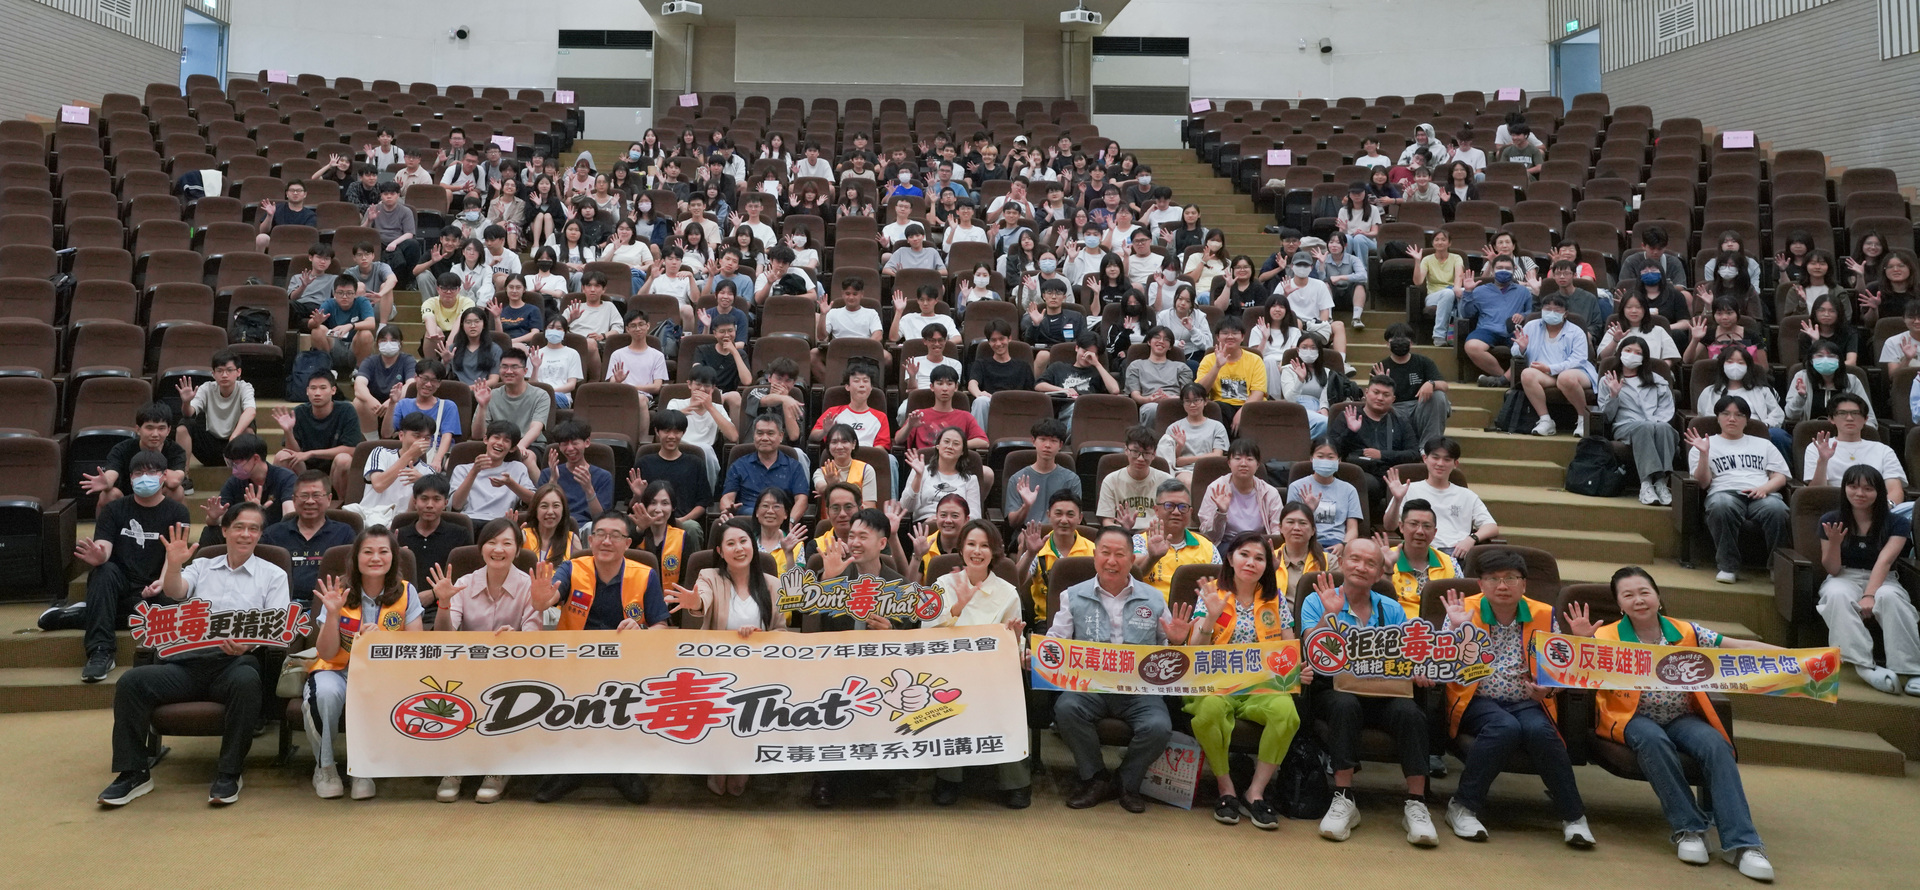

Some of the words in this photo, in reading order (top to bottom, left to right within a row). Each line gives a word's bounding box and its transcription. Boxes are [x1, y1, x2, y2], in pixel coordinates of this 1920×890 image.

[1712, 456, 1737, 473] NEW
[1738, 454, 1764, 471] YORK
[1118, 496, 1155, 508] MICHIGA
[803, 584, 848, 608] Don't
[847, 579, 883, 618] 毒
[878, 593, 918, 616] That
[143, 600, 302, 648] 無毒更精彩!
[370, 643, 620, 659] 國際獅子會300E-2區
[678, 637, 998, 660] 2026-2027年度反毒委員會
[1043, 640, 1060, 665] 毒
[1347, 623, 1459, 662] 拒絕毒品
[1549, 641, 1569, 663] 毒
[1068, 645, 1135, 674] 反毒雄獅
[1194, 648, 1263, 675] 高興有您
[1354, 661, 1454, 679] 擁抱更好的自己
[1578, 643, 1652, 677] 反毒雄獅
[1719, 654, 1800, 678] 高興有您
[485, 684, 642, 731] Don't
[635, 671, 735, 741] 毒
[726, 688, 851, 732] That
[914, 712, 942, 724] BETTER
[924, 705, 949, 715] DRUGS
[754, 735, 1005, 764] 反毒宣導系列講座
